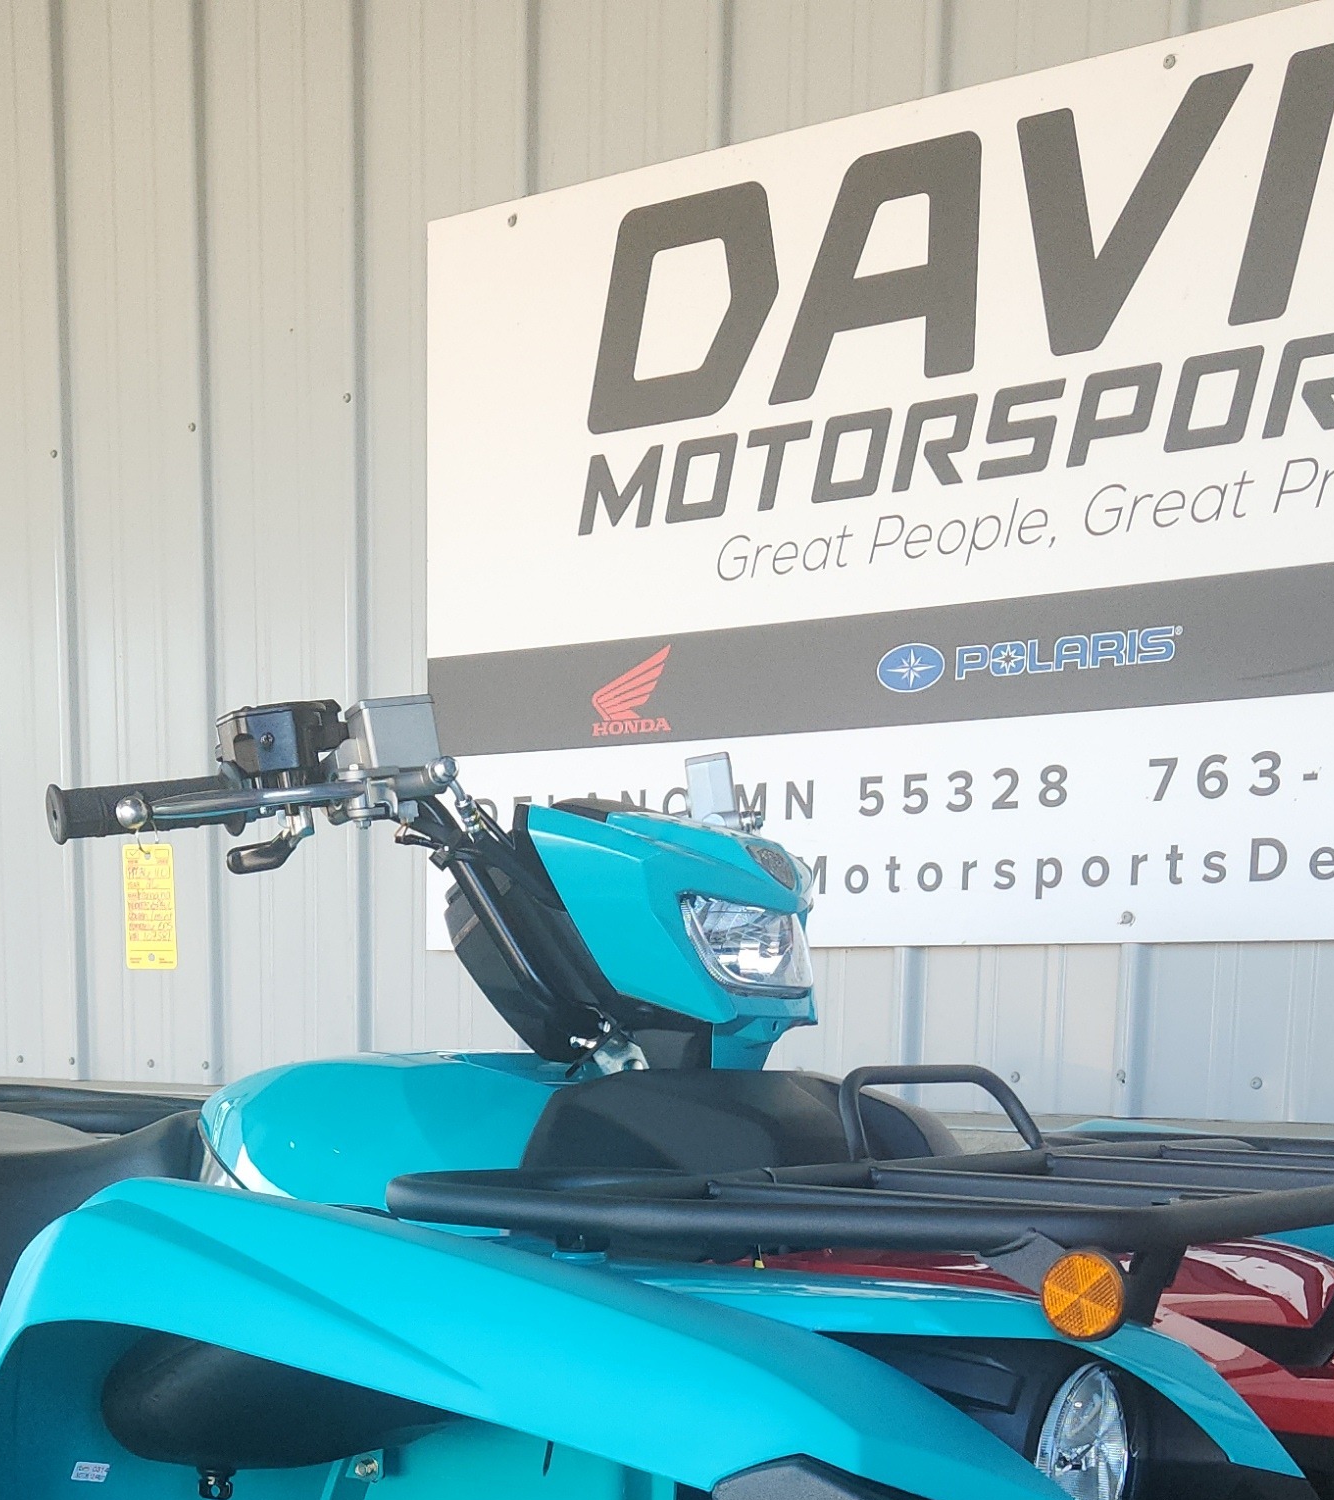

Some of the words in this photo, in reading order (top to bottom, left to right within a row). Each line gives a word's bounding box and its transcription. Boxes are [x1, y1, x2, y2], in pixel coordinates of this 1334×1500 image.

[717, 525, 853, 581] Great
[869, 498, 1057, 566] People,
[1084, 470, 1255, 536] Great
[955, 626, 1177, 681] POLARIS
[591, 717, 671, 737] HONDA
[858, 764, 1069, 816] 55328
